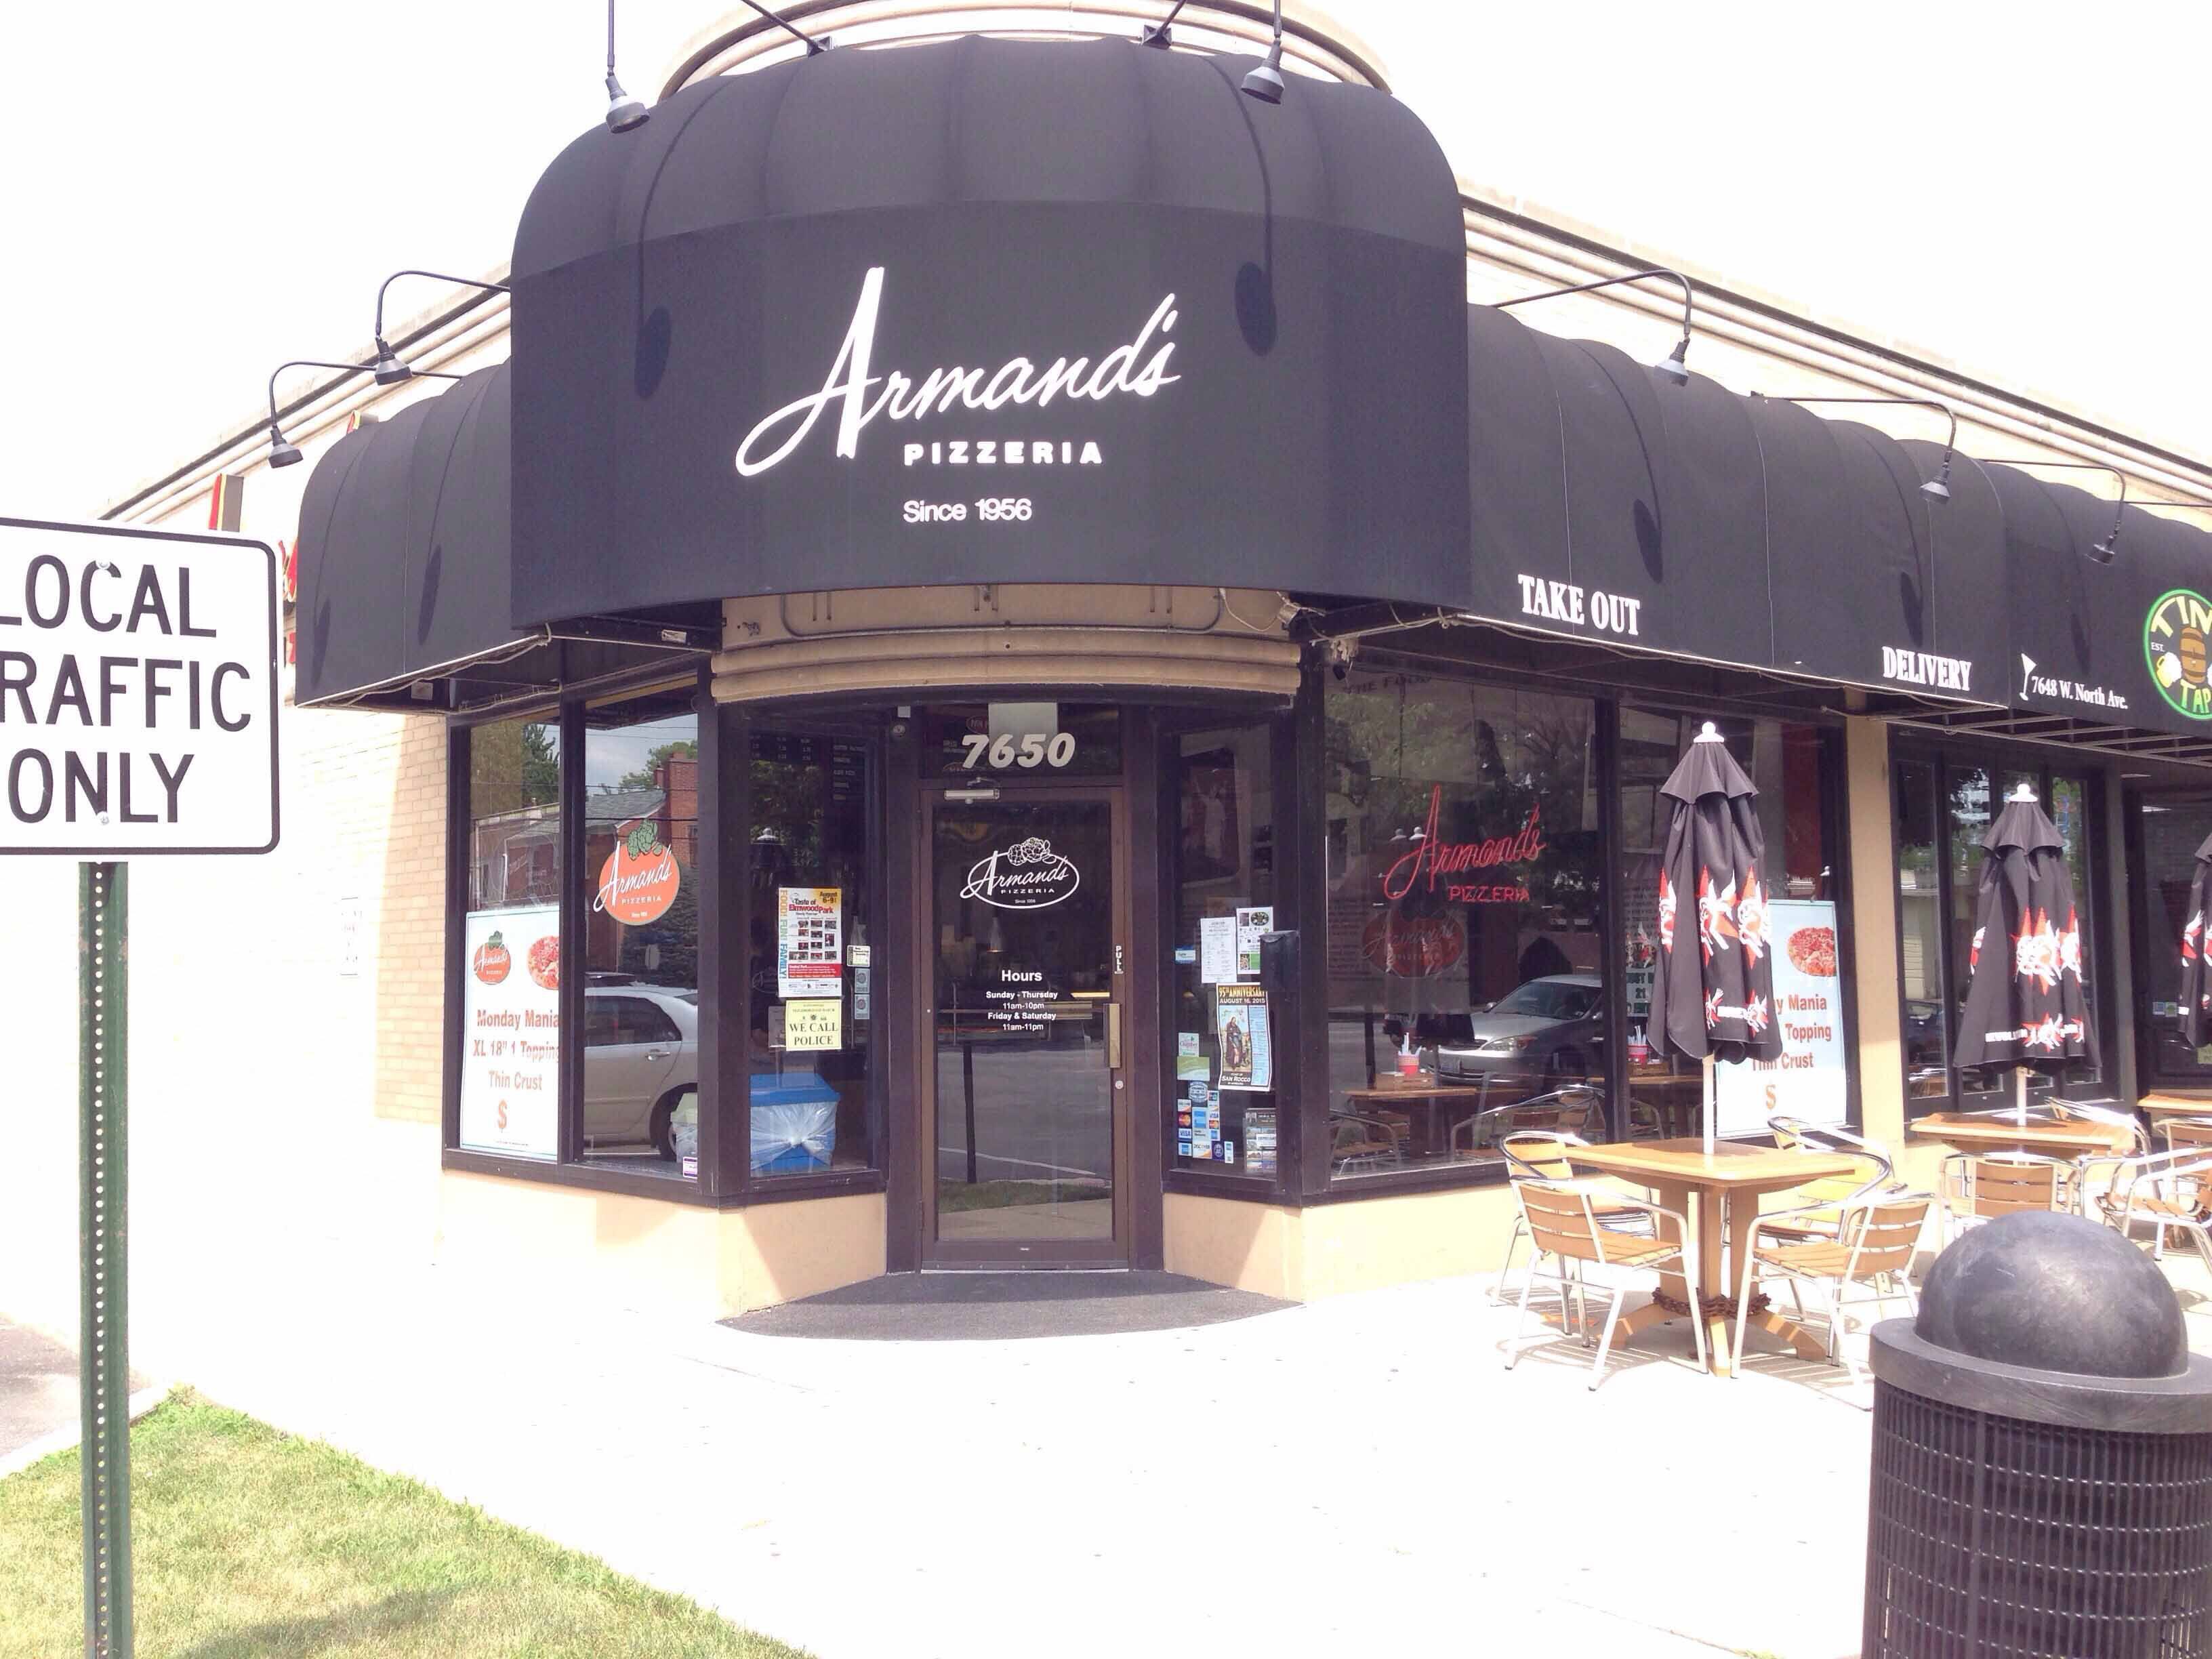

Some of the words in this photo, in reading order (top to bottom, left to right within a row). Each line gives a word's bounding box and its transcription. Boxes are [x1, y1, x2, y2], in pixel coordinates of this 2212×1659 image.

[735, 267, 1181, 476] Armand's
[903, 441, 1103, 466] PIZZERIA
[903, 499, 966, 523] Since
[975, 498, 1032, 521] 1956
[1517, 574, 1584, 625] TAKE
[1591, 591, 1640, 636] OUT
[2150, 596, 2212, 638] TIN
[1882, 646, 1972, 691] DELIVERY
[0, 651, 251, 732] RAFFIC
[2032, 676, 2057, 697] 7648
[2060, 681, 2074, 699] W.
[2075, 684, 2105, 705] North
[2106, 688, 2129, 710] Ave.
[962, 733, 1076, 769] 7650
[7, 748, 194, 823] ONLY
[593, 840, 672, 912] Armand's
[960, 851, 1069, 899] Armand's
[621, 896, 662, 905] PIZZERIA
[1448, 884, 1530, 901] PIZZERIA
[1002, 970, 1042, 982] Hours
[986, 991, 1015, 1000] Sunday
[1021, 991, 1058, 1000] Thursday
[1788, 994, 1827, 1010] Mania
[477, 1009, 521, 1031] Monday
[525, 1009, 559, 1028] Mania
[789, 1023, 806, 1032] WE
[809, 1022, 839, 1032] CALL
[988, 1012, 1012, 1021] Friday
[1022, 1012, 1057, 1021] Saturday
[794, 1036, 834, 1046] POLICE
[1784, 1022, 1832, 1043] Topping
[473, 1039, 487, 1057] XL
[1781, 1052, 1814, 1069] Crust
[488, 1070, 510, 1088] Thin
[514, 1071, 543, 1090] Crust
[1765, 1083, 1776, 1111] $
[497, 1099, 508, 1133] $
